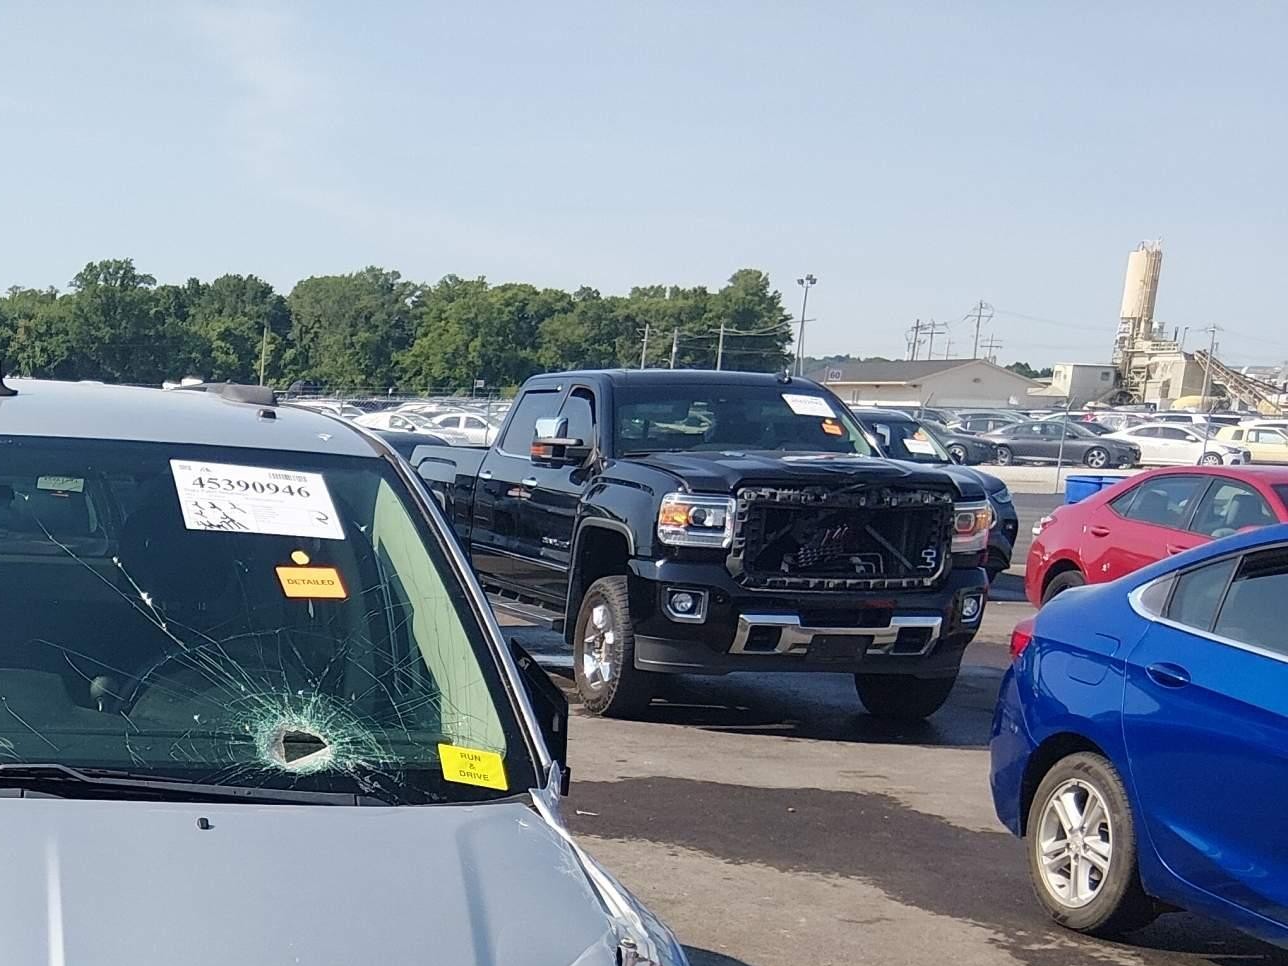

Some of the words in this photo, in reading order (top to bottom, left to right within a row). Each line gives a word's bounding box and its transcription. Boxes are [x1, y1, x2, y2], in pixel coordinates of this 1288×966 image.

[830, 371, 841, 379] 60
[192, 475, 311, 499] 45390946
[286, 577, 336, 587] DETAILED
[459, 752, 481, 762] RUN
[458, 769, 489, 782] DRIVE
